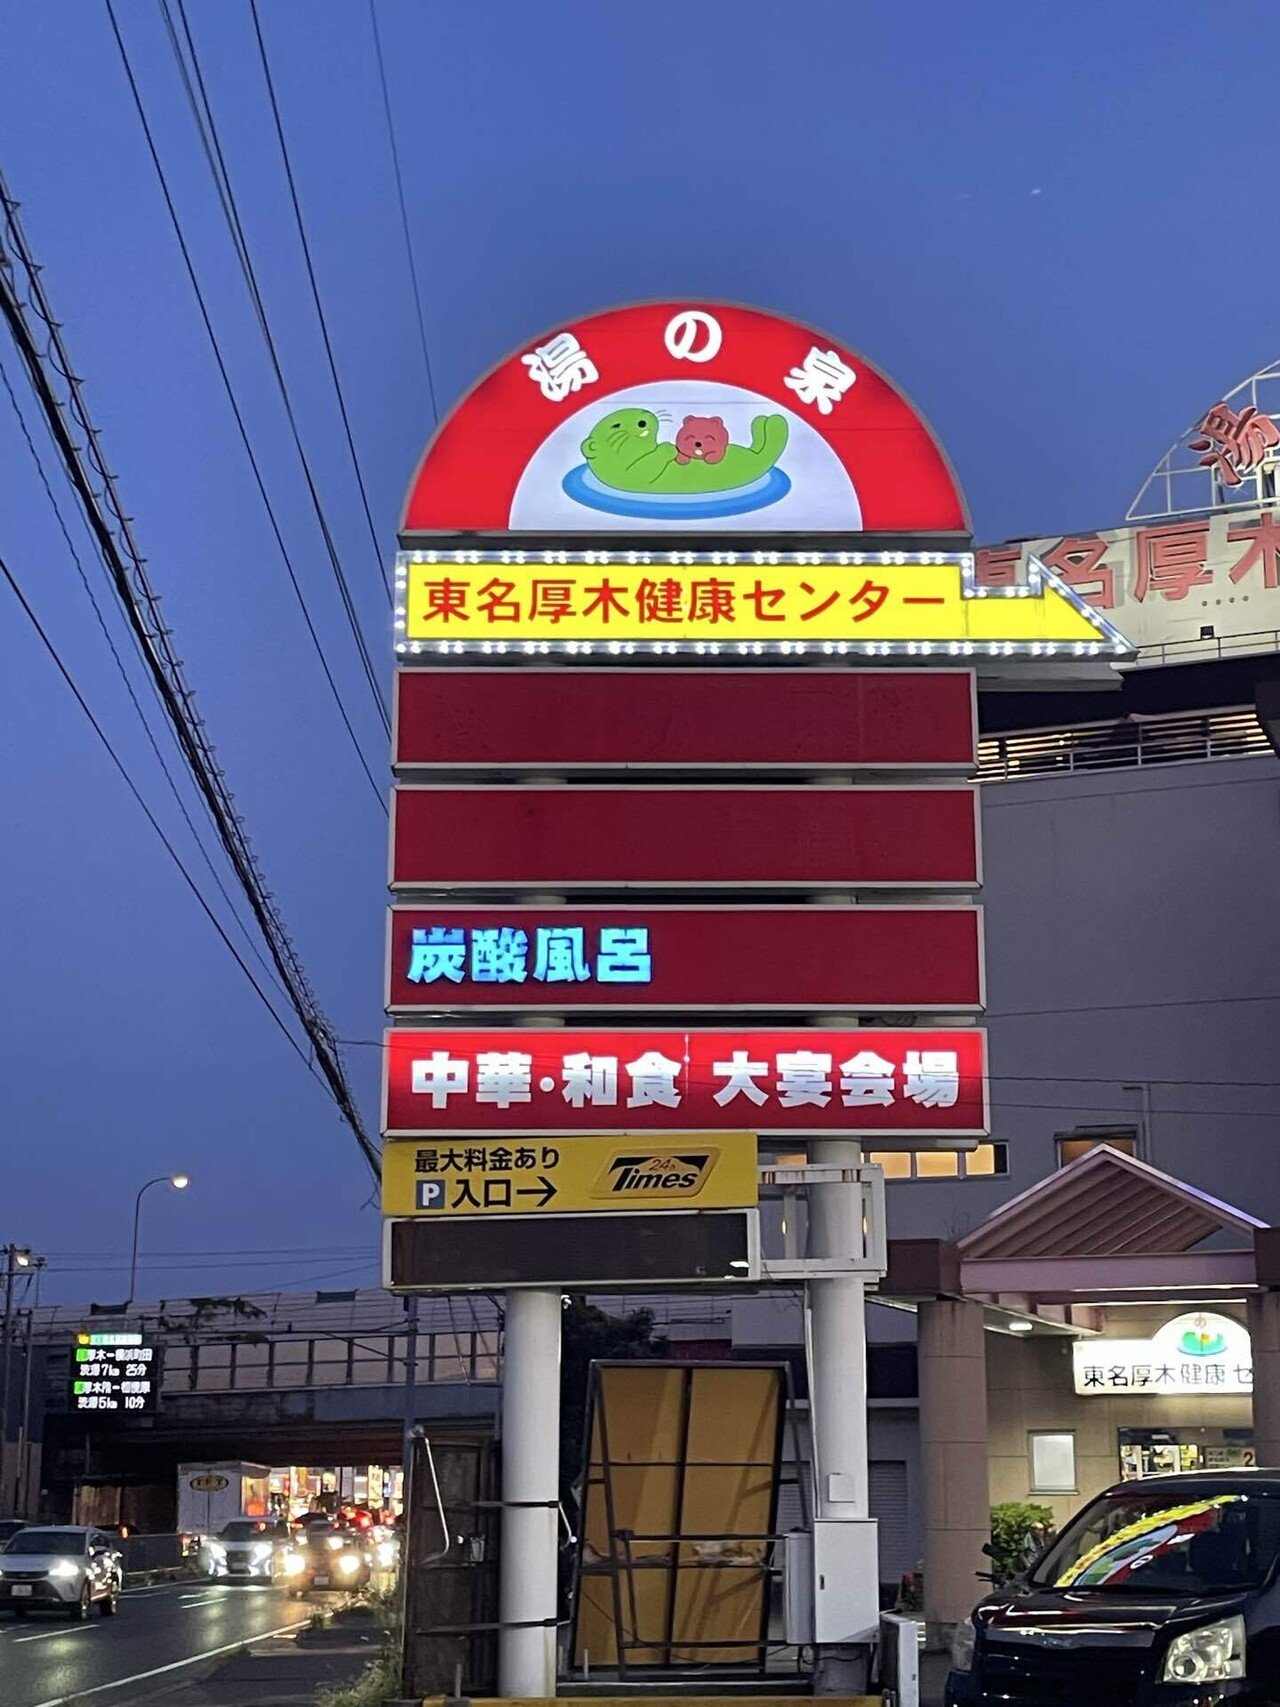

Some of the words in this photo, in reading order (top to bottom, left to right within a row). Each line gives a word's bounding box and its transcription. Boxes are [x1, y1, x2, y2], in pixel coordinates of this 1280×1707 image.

[422, 577, 945, 625] 東名厚木健康センター
[407, 926, 652, 984] 炭酸風呂
[411, 1051, 683, 1109] 中華・和食
[712, 1051, 960, 1109] 大宴会場
[414, 1146, 560, 1173] 最大料金あり
[451, 1178, 512, 1209] 入口
[611, 1167, 699, 1192] Times
[1083, 1363, 1254, 1388] 東名厚木健康セ
